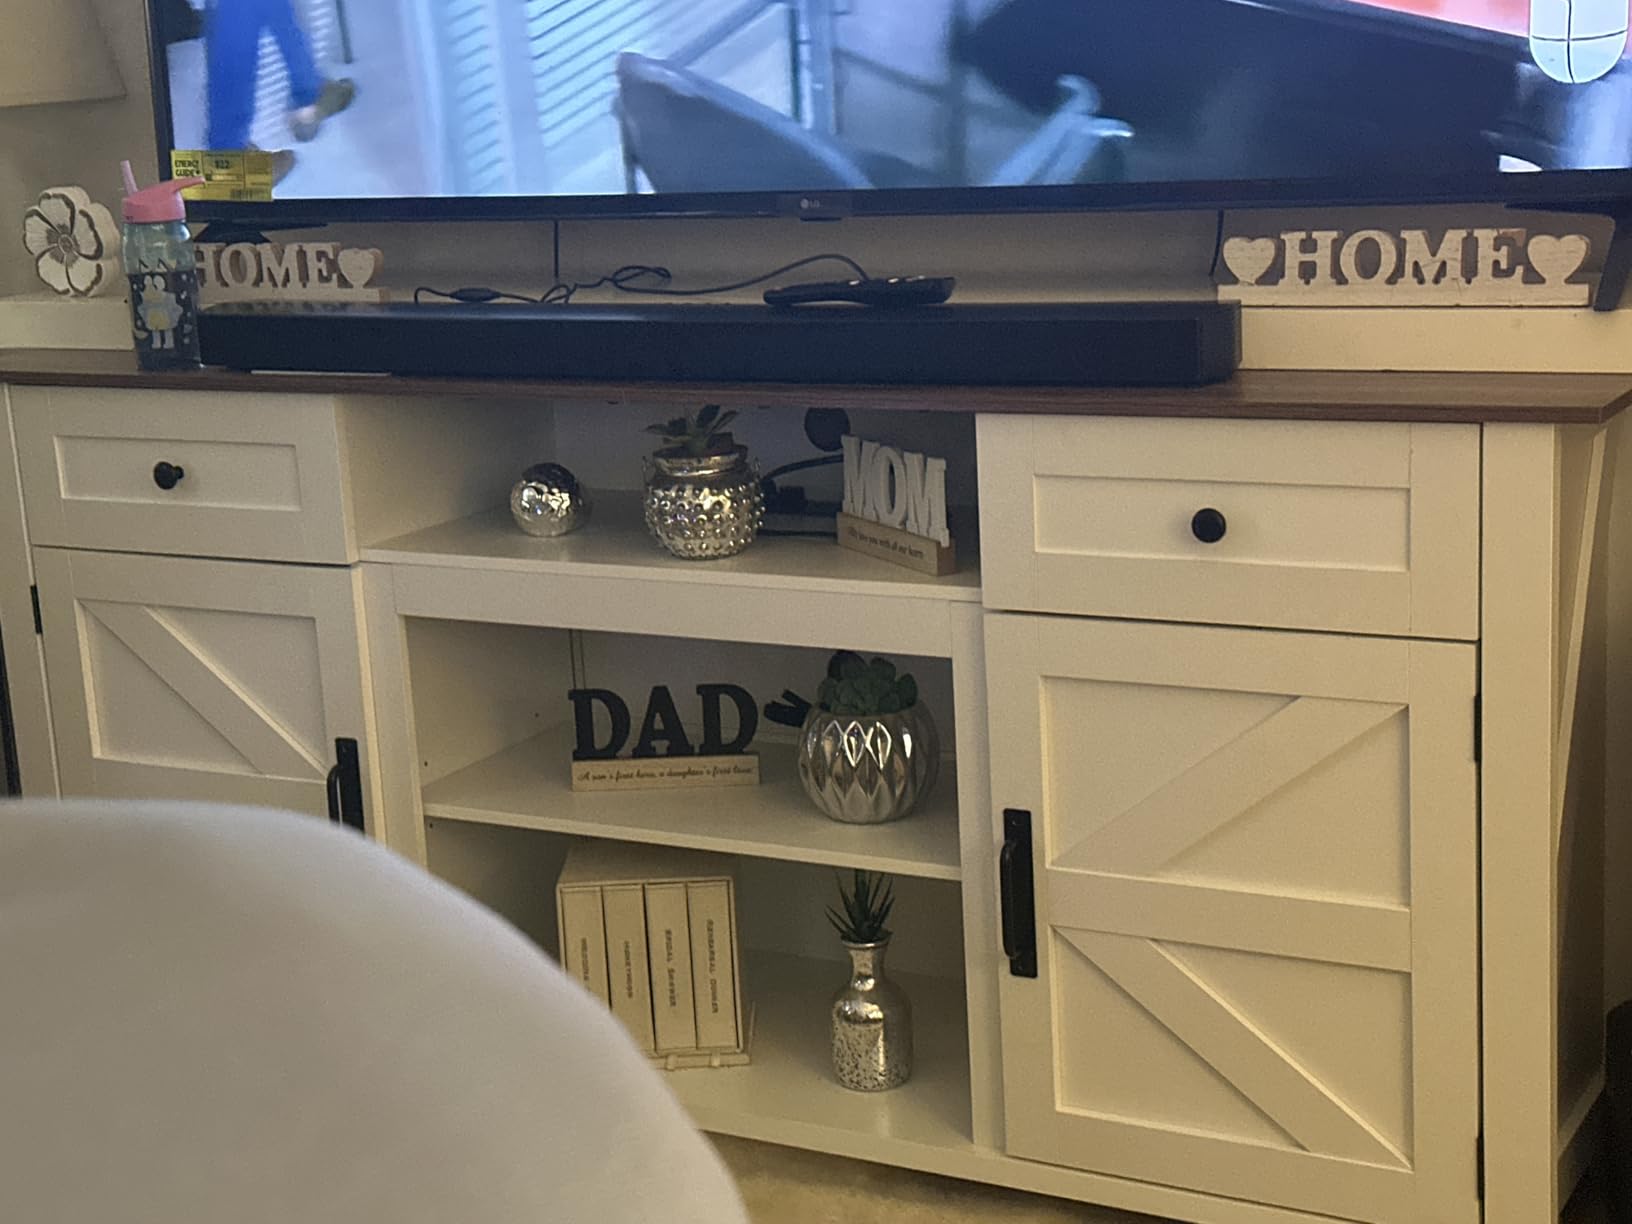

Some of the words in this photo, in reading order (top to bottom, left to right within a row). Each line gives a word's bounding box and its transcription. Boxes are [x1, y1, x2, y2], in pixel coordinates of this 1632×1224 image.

[174, 159, 200, 169] ENERGY
[175, 169, 195, 177] GUIDE
[1278, 228, 1526, 286] HOME
[840, 434, 950, 548] MOM
[568, 683, 759, 760] DAD
[664, 929, 673, 963] BRIDAL
[706, 919, 716, 974] REHEARSAL
[623, 941, 633, 999] HONEYMOON
[667, 968, 677, 1007] SHOWER
[709, 979, 719, 1013] DINNER
